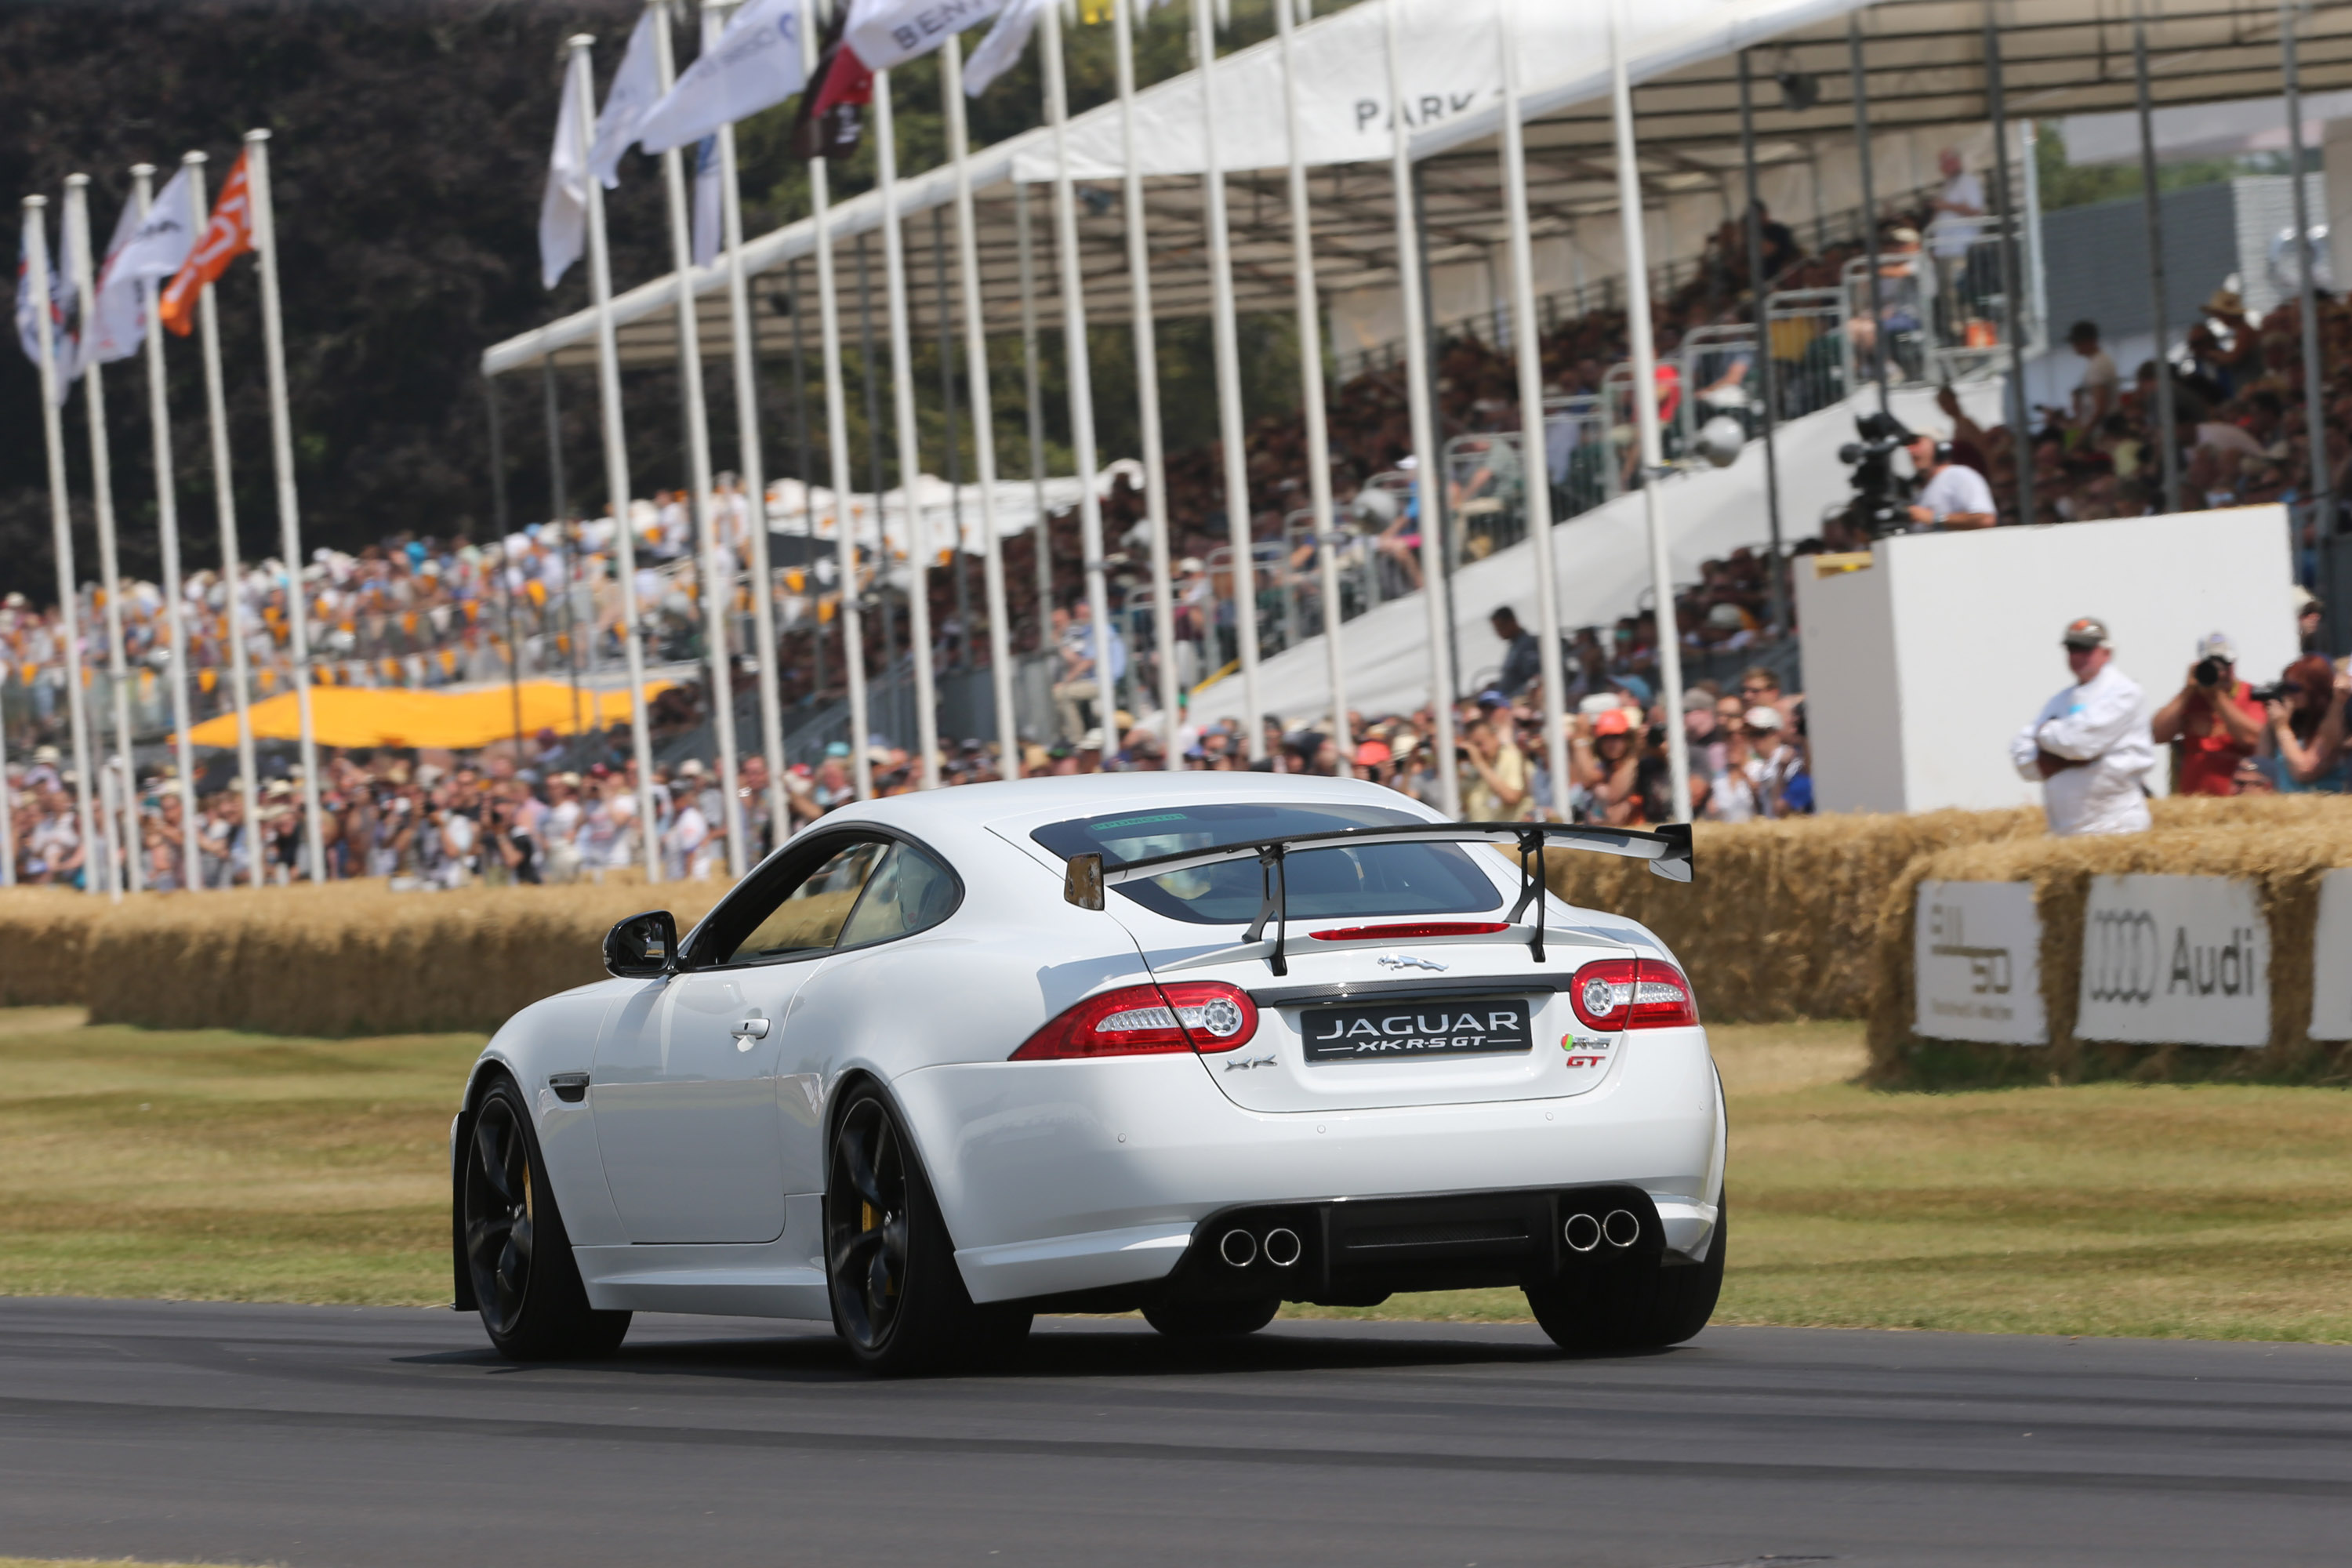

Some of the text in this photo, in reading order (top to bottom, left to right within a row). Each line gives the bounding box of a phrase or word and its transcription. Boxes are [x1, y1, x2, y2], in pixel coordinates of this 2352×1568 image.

[2166, 926, 2253, 997] Audi
[1316, 1011, 1520, 1040] JAGUAR
[1451, 1036, 1486, 1047] GT
[1224, 1054, 1278, 1073] XK
[1566, 1055, 1606, 1068] GT
